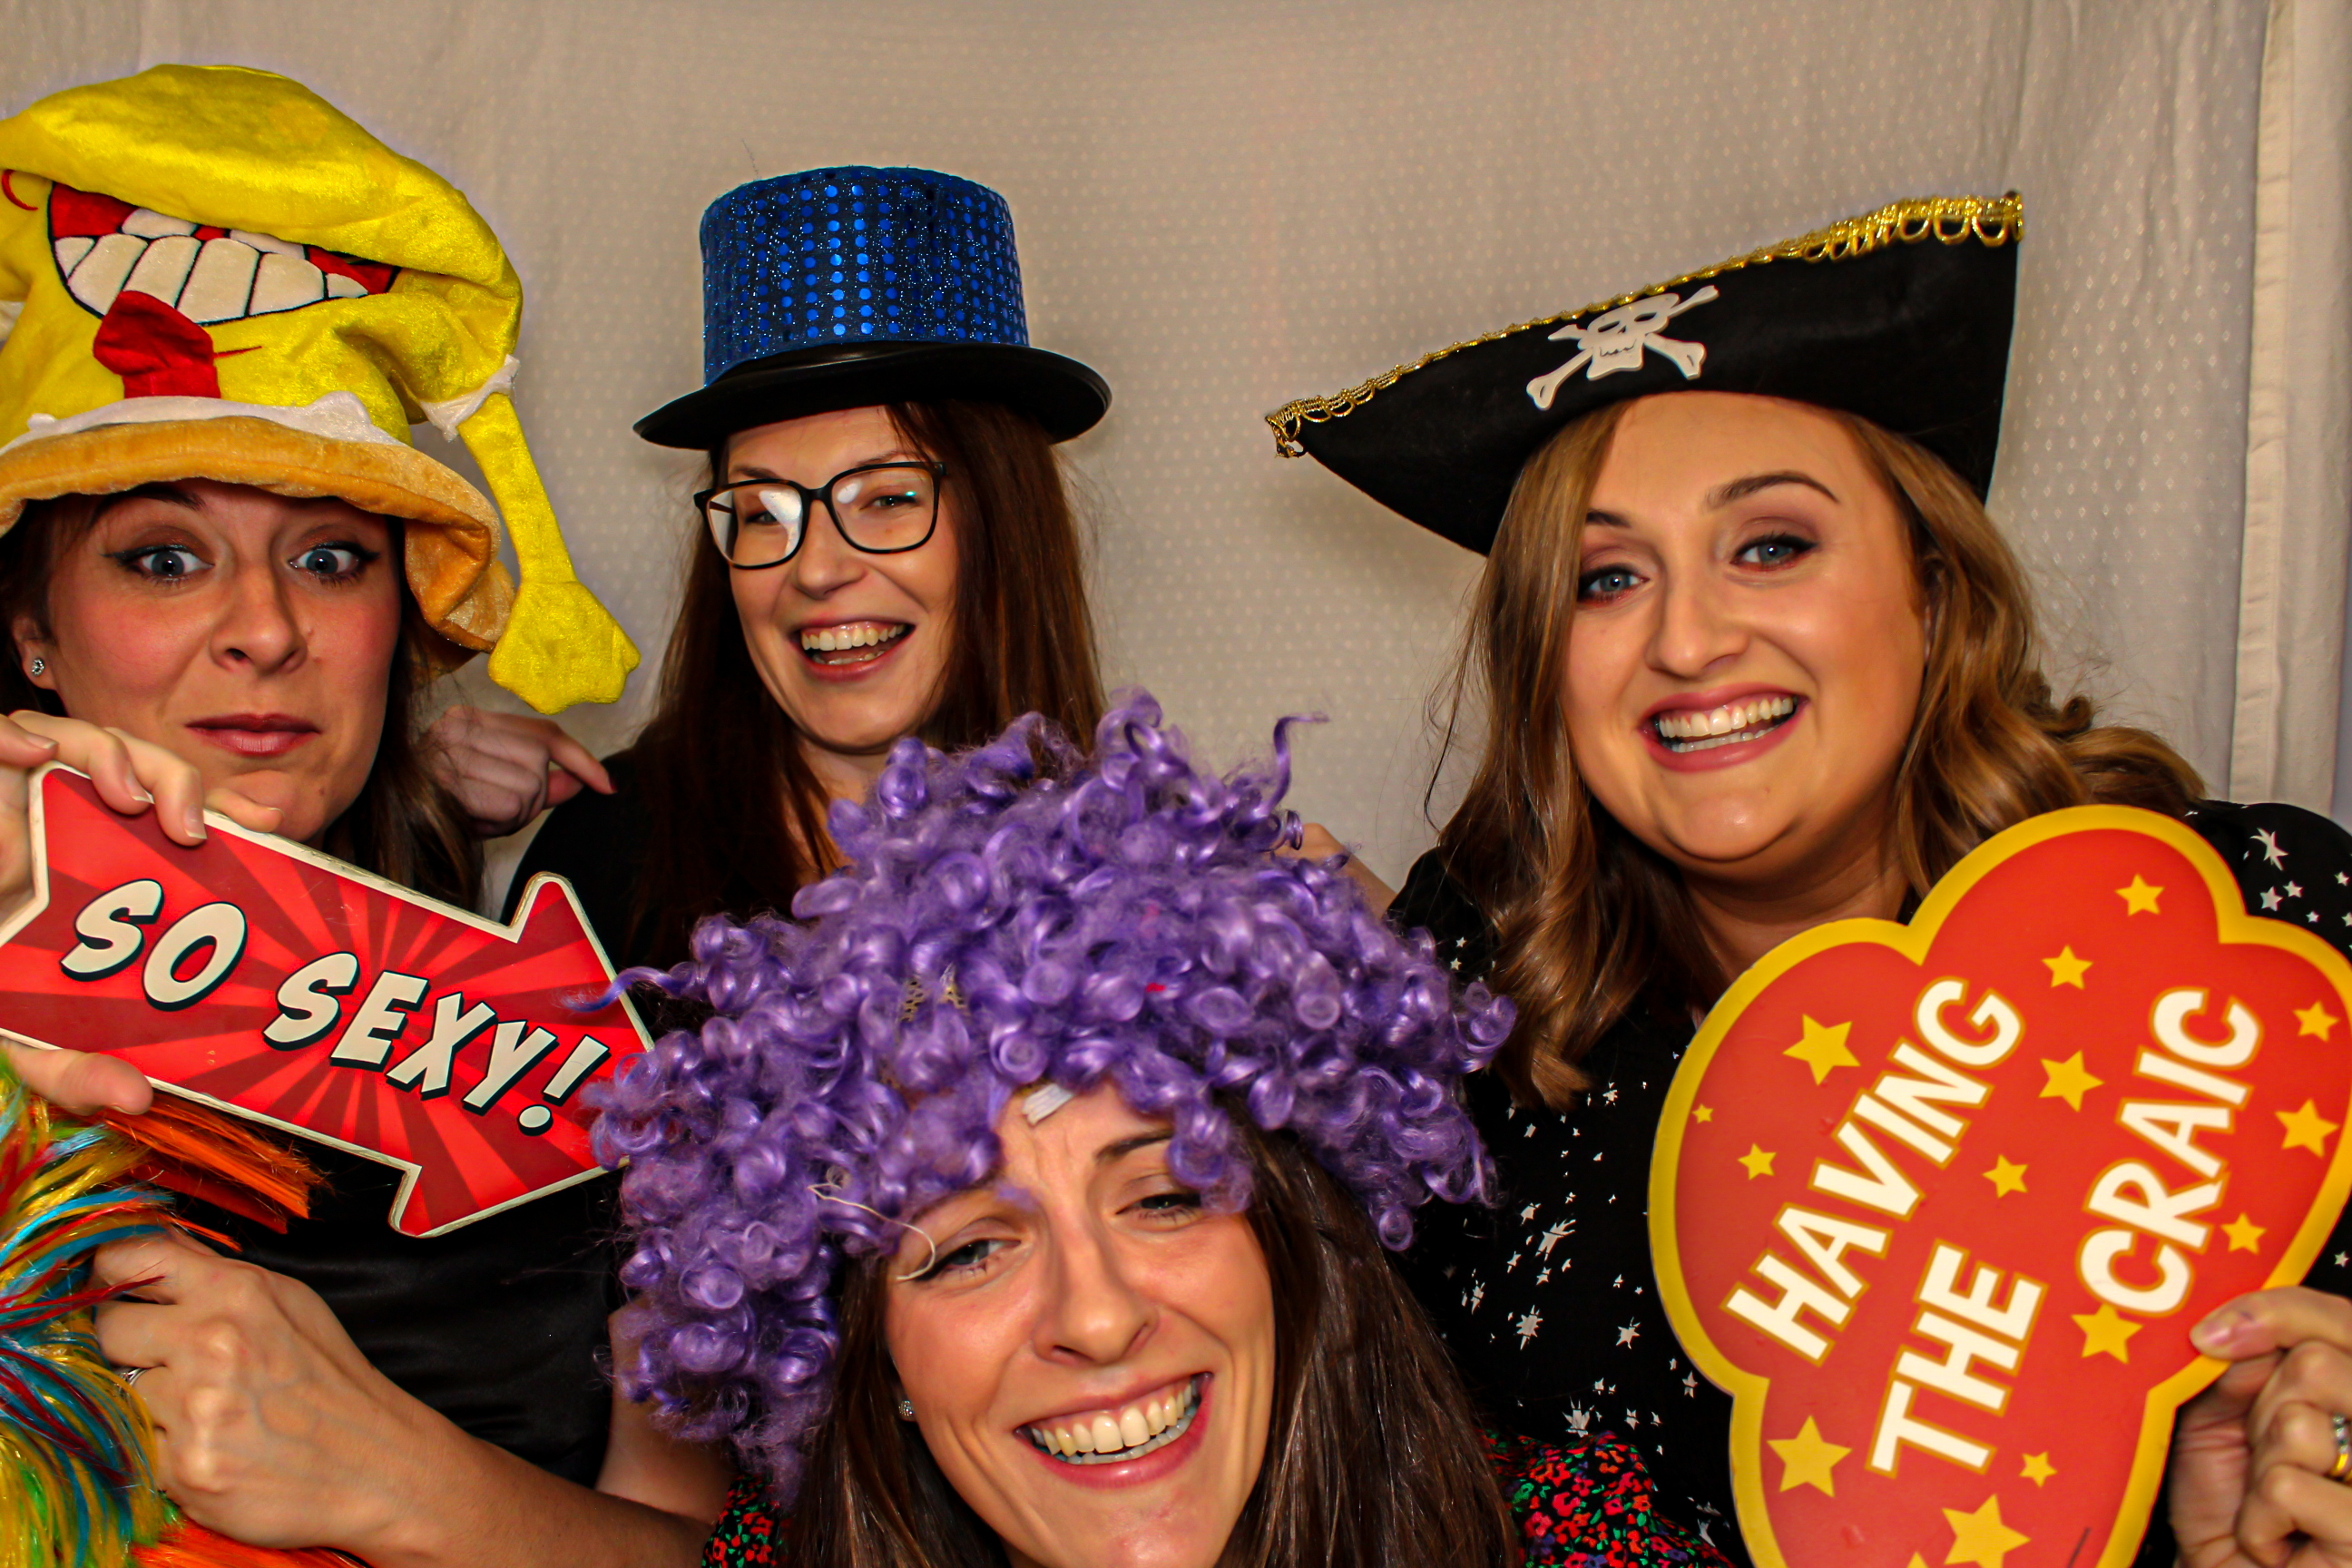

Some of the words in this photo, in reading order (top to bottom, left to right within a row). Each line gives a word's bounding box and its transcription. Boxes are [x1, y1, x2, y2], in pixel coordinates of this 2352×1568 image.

[61, 879, 248, 1011] SO
[263, 952, 612, 1135] SEXY!
[2077, 987, 2262, 1316] CRAIC
[1723, 977, 2023, 1363] HAVING
[1867, 1240, 2047, 1477] THE
